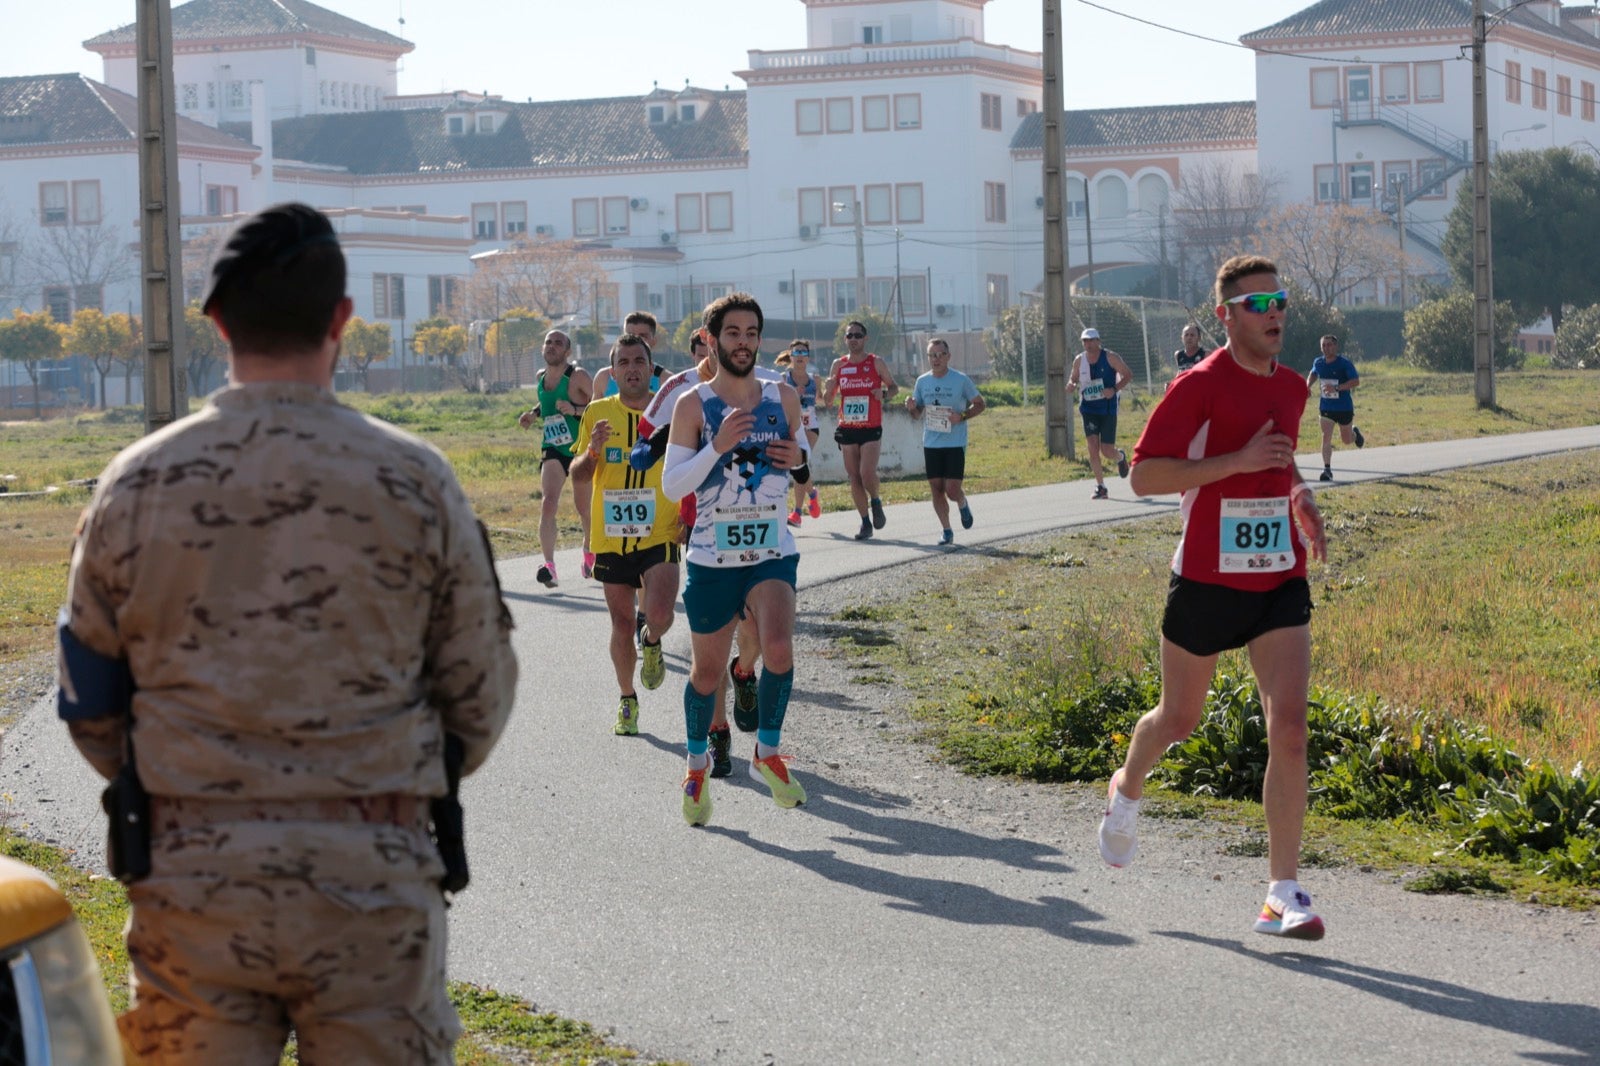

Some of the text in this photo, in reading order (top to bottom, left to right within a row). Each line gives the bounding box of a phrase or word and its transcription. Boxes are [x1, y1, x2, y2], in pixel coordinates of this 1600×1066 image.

[846, 404, 865, 414] 720
[750, 431, 781, 443] SUMA
[612, 504, 648, 522] 319
[727, 523, 769, 547] 557
[1235, 522, 1281, 549] 897
